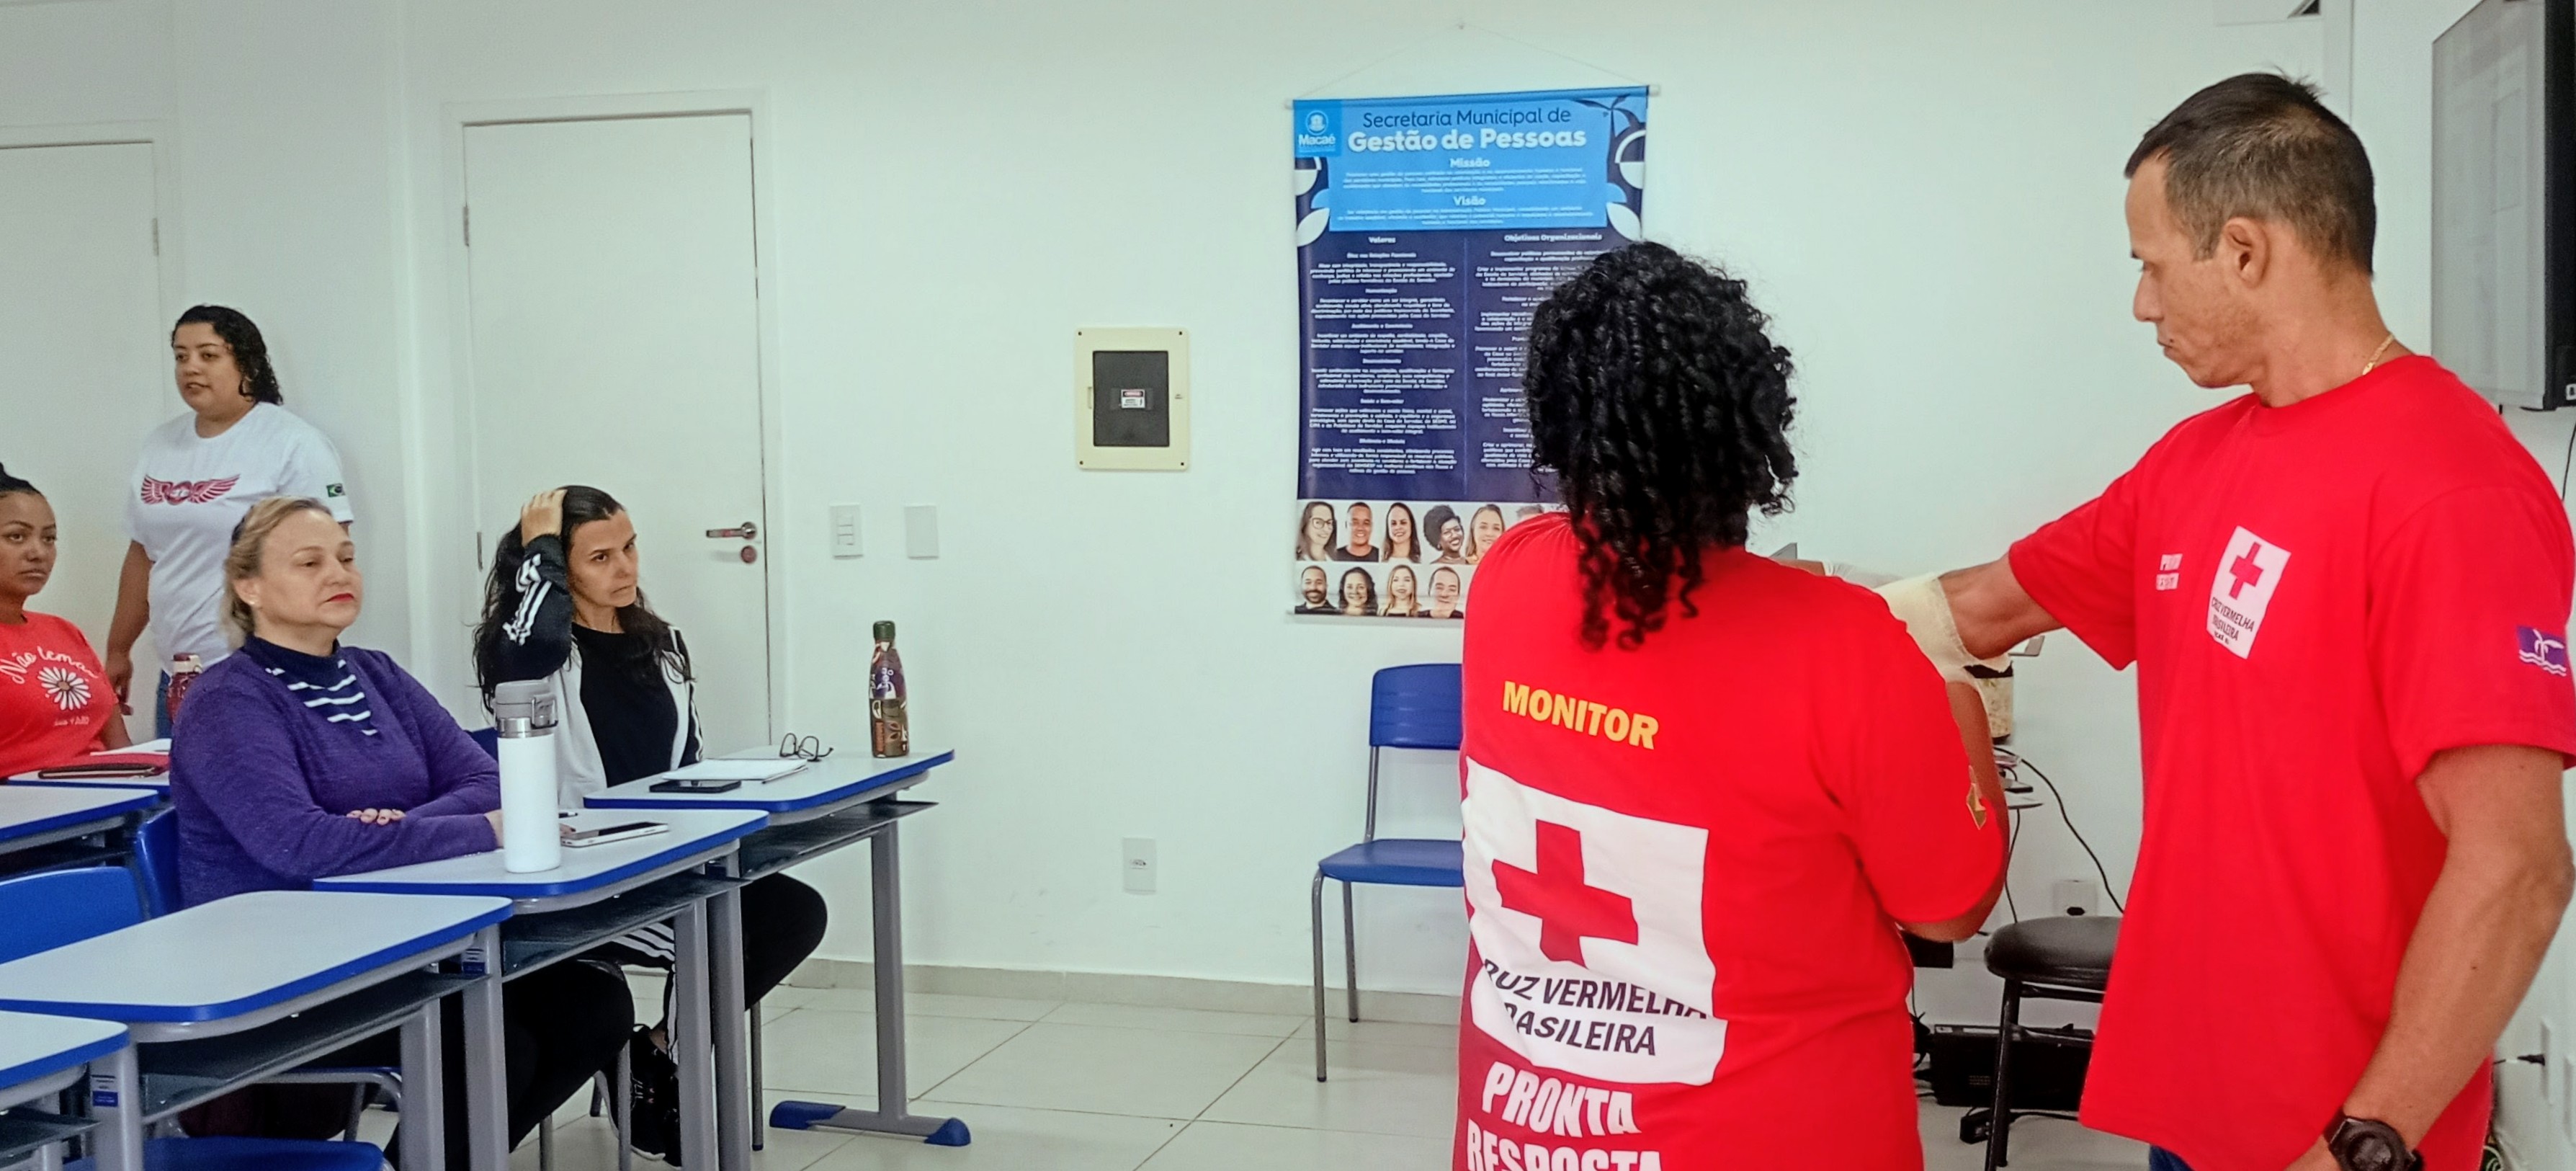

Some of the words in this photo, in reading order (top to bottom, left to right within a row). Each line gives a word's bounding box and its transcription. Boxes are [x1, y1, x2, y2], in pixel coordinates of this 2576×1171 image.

[1363, 112, 1452, 128] Secretaria
[1457, 108, 1543, 128] Municipal
[1547, 108, 1571, 123] de
[1298, 133, 1336, 146] Macaé
[1348, 130, 1438, 153] Gestão
[1441, 128, 1475, 150] de
[1480, 128, 1587, 149] Pessoas
[1449, 157, 1491, 169] Missão
[1453, 195, 1486, 206] Visão
[0, 651, 37, 684] Não
[1503, 680, 1659, 750] MONITOR
[1485, 958, 1540, 1001] RUZ
[1504, 1002, 1656, 1056] ASILEIRA
[1482, 1061, 1643, 1138] PRONTA
